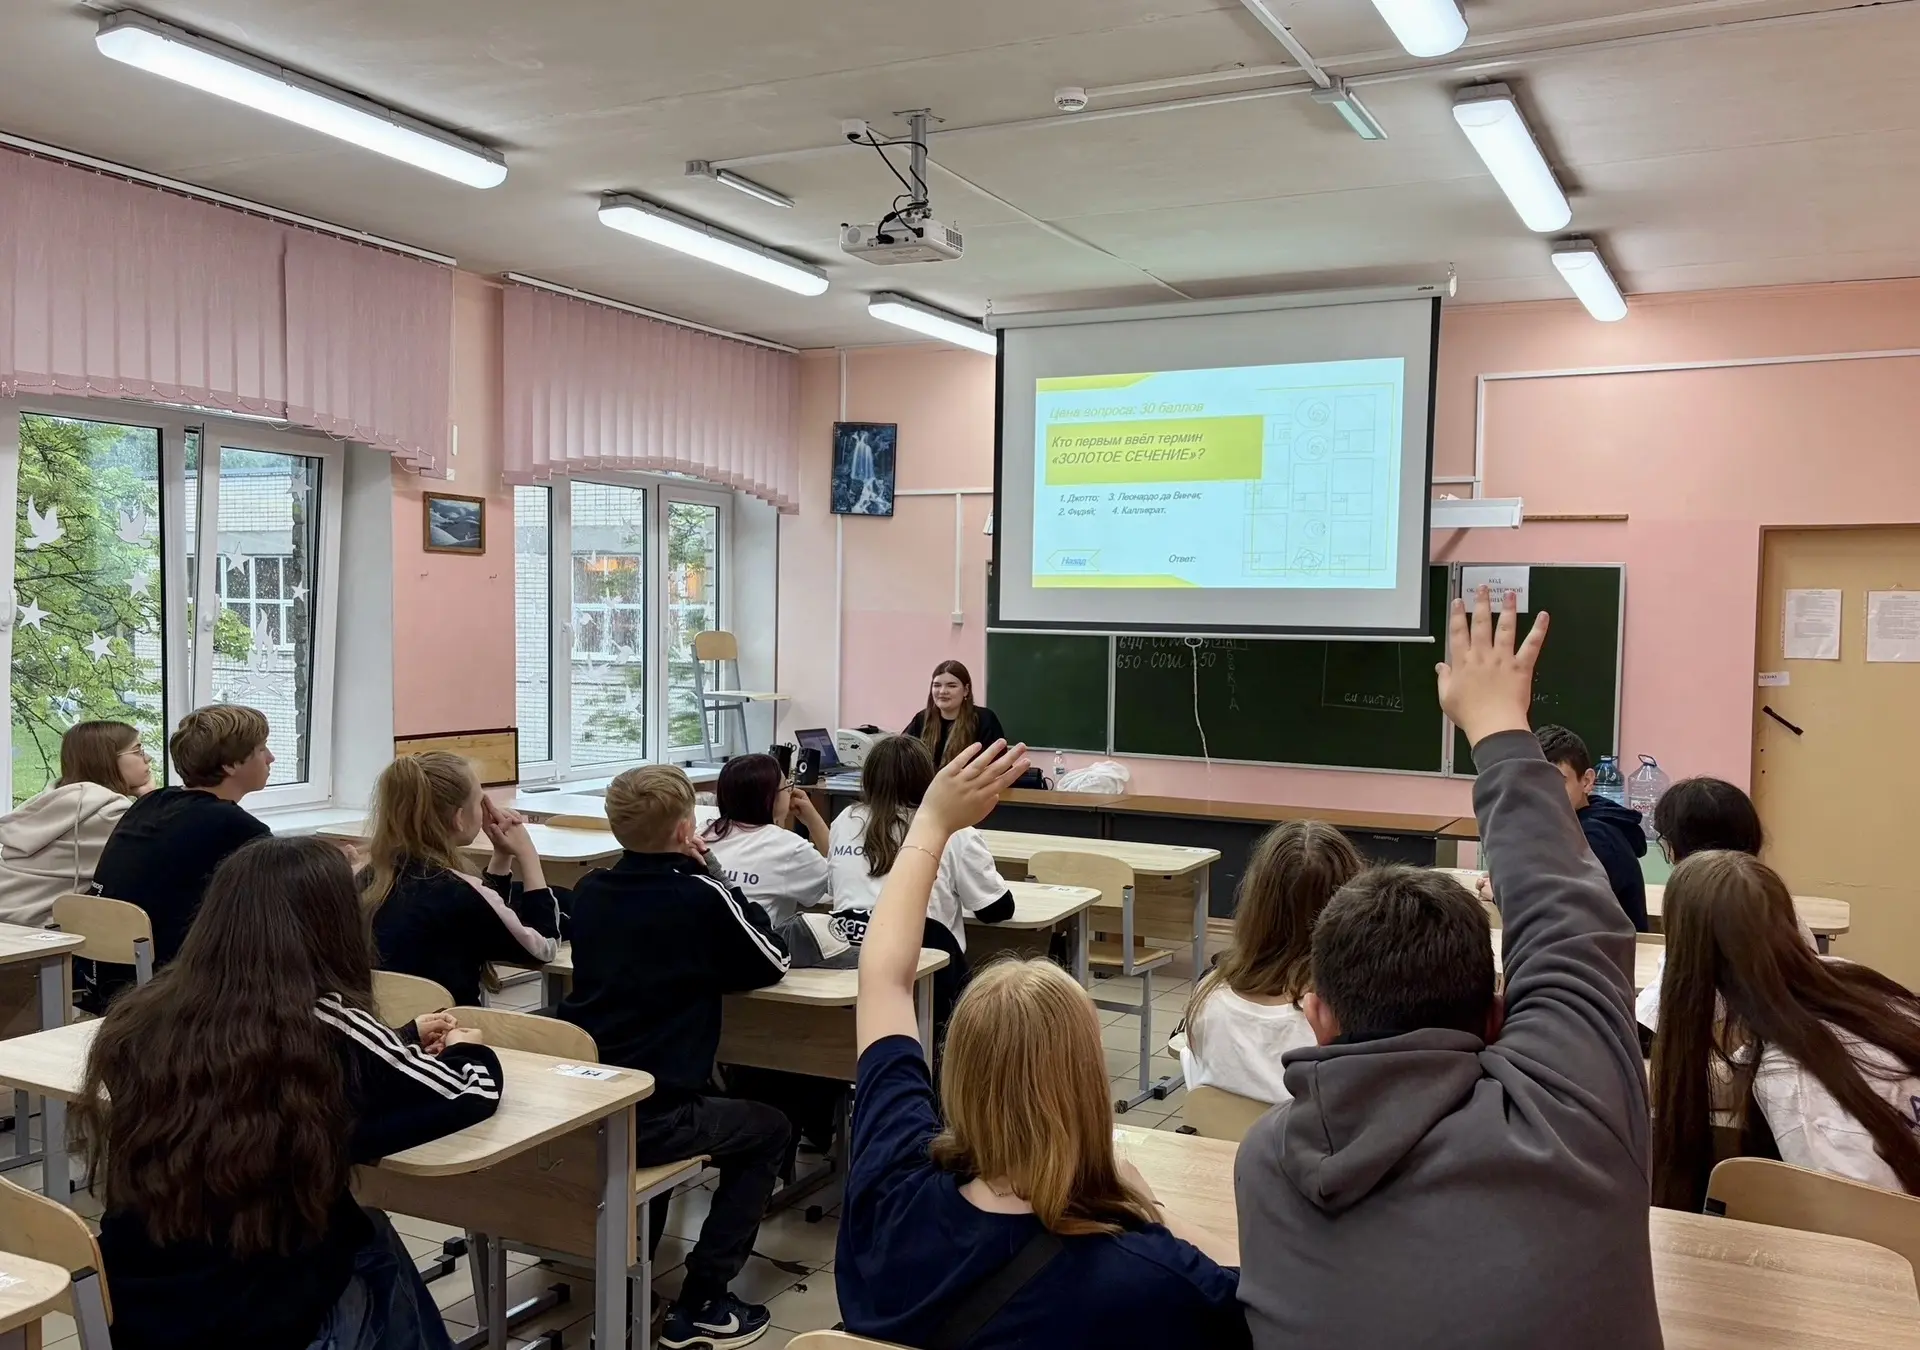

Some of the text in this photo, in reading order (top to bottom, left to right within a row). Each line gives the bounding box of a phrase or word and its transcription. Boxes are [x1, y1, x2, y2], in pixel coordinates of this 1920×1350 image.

[1050, 402, 1204, 419] Цена вопроса: 30 баллов
[1052, 432, 1204, 449] Кто первым ввёл термин
[1052, 450, 1122, 464] «ЗОЛОТОЕ
[1117, 492, 1159, 502] Леонардо
[1160, 493, 1171, 501] да
[1061, 556, 1087, 567] Назад
[1168, 554, 1196, 564] Ответ:
[743, 872, 759, 885] 10
